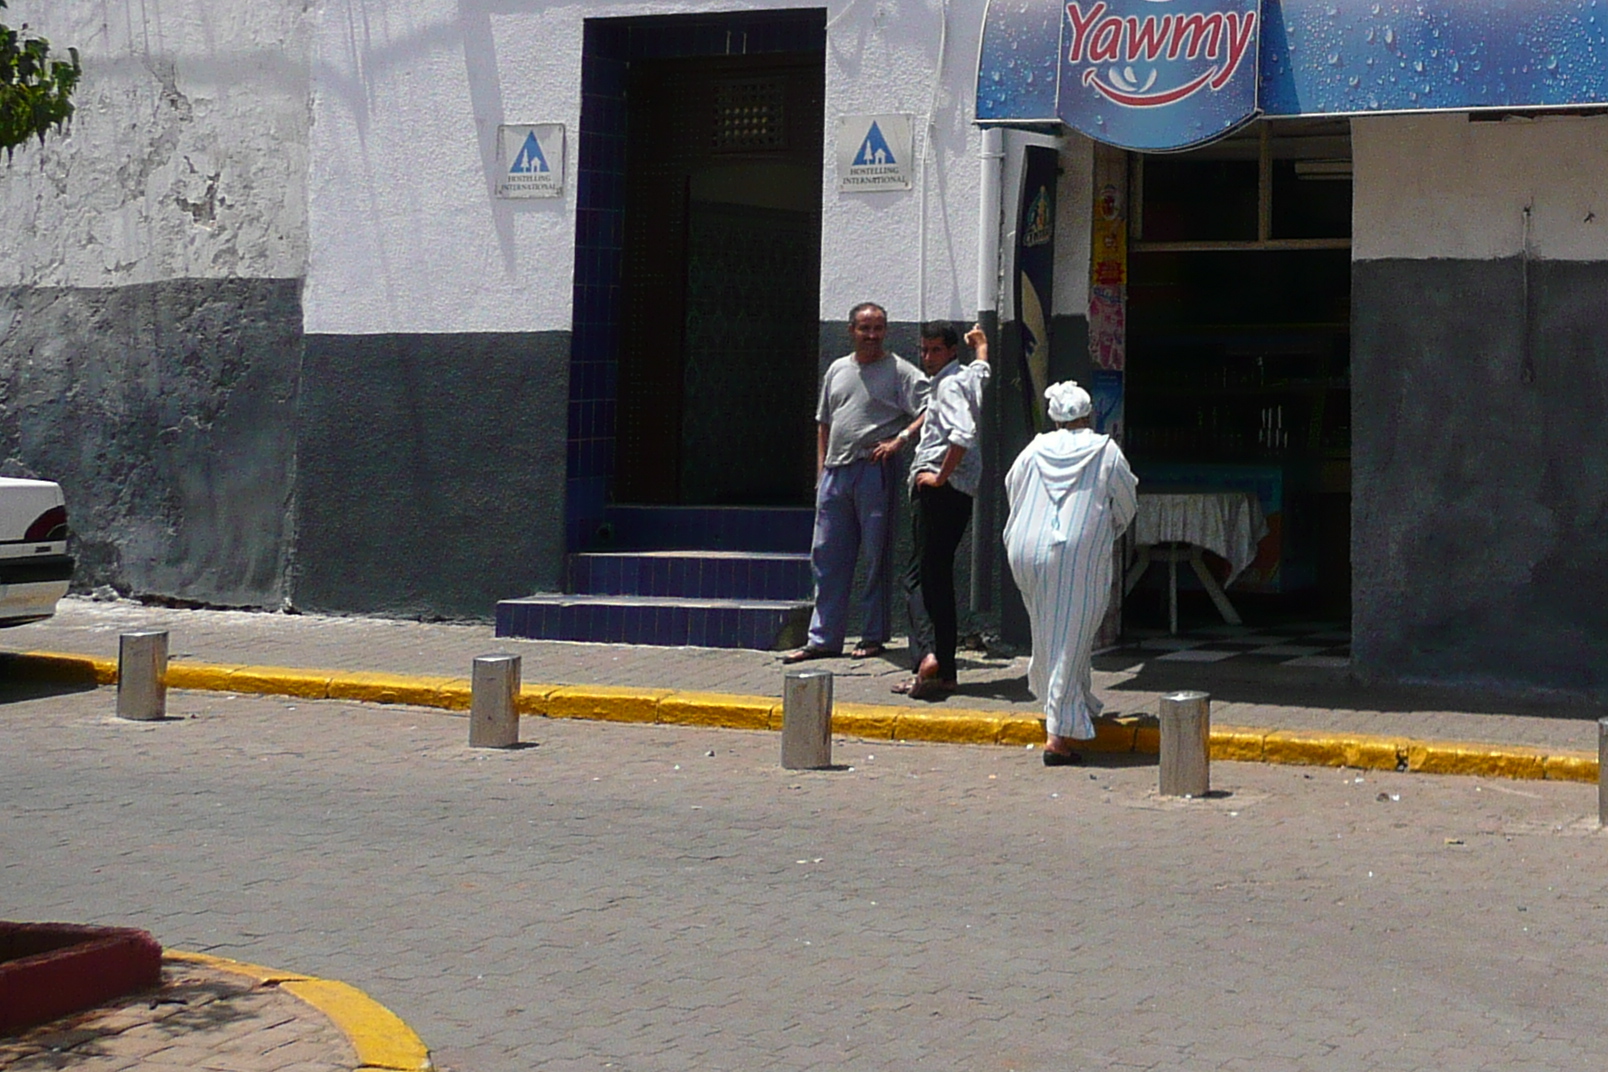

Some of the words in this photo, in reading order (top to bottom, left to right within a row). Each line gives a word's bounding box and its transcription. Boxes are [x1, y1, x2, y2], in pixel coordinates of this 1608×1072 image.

[1065, 1, 1257, 91] Yawmy
[850, 167, 899, 175] HOSTELLING
[508, 175, 551, 183] HOSTELLING
[842, 175, 905, 185] INTERNATIONAL
